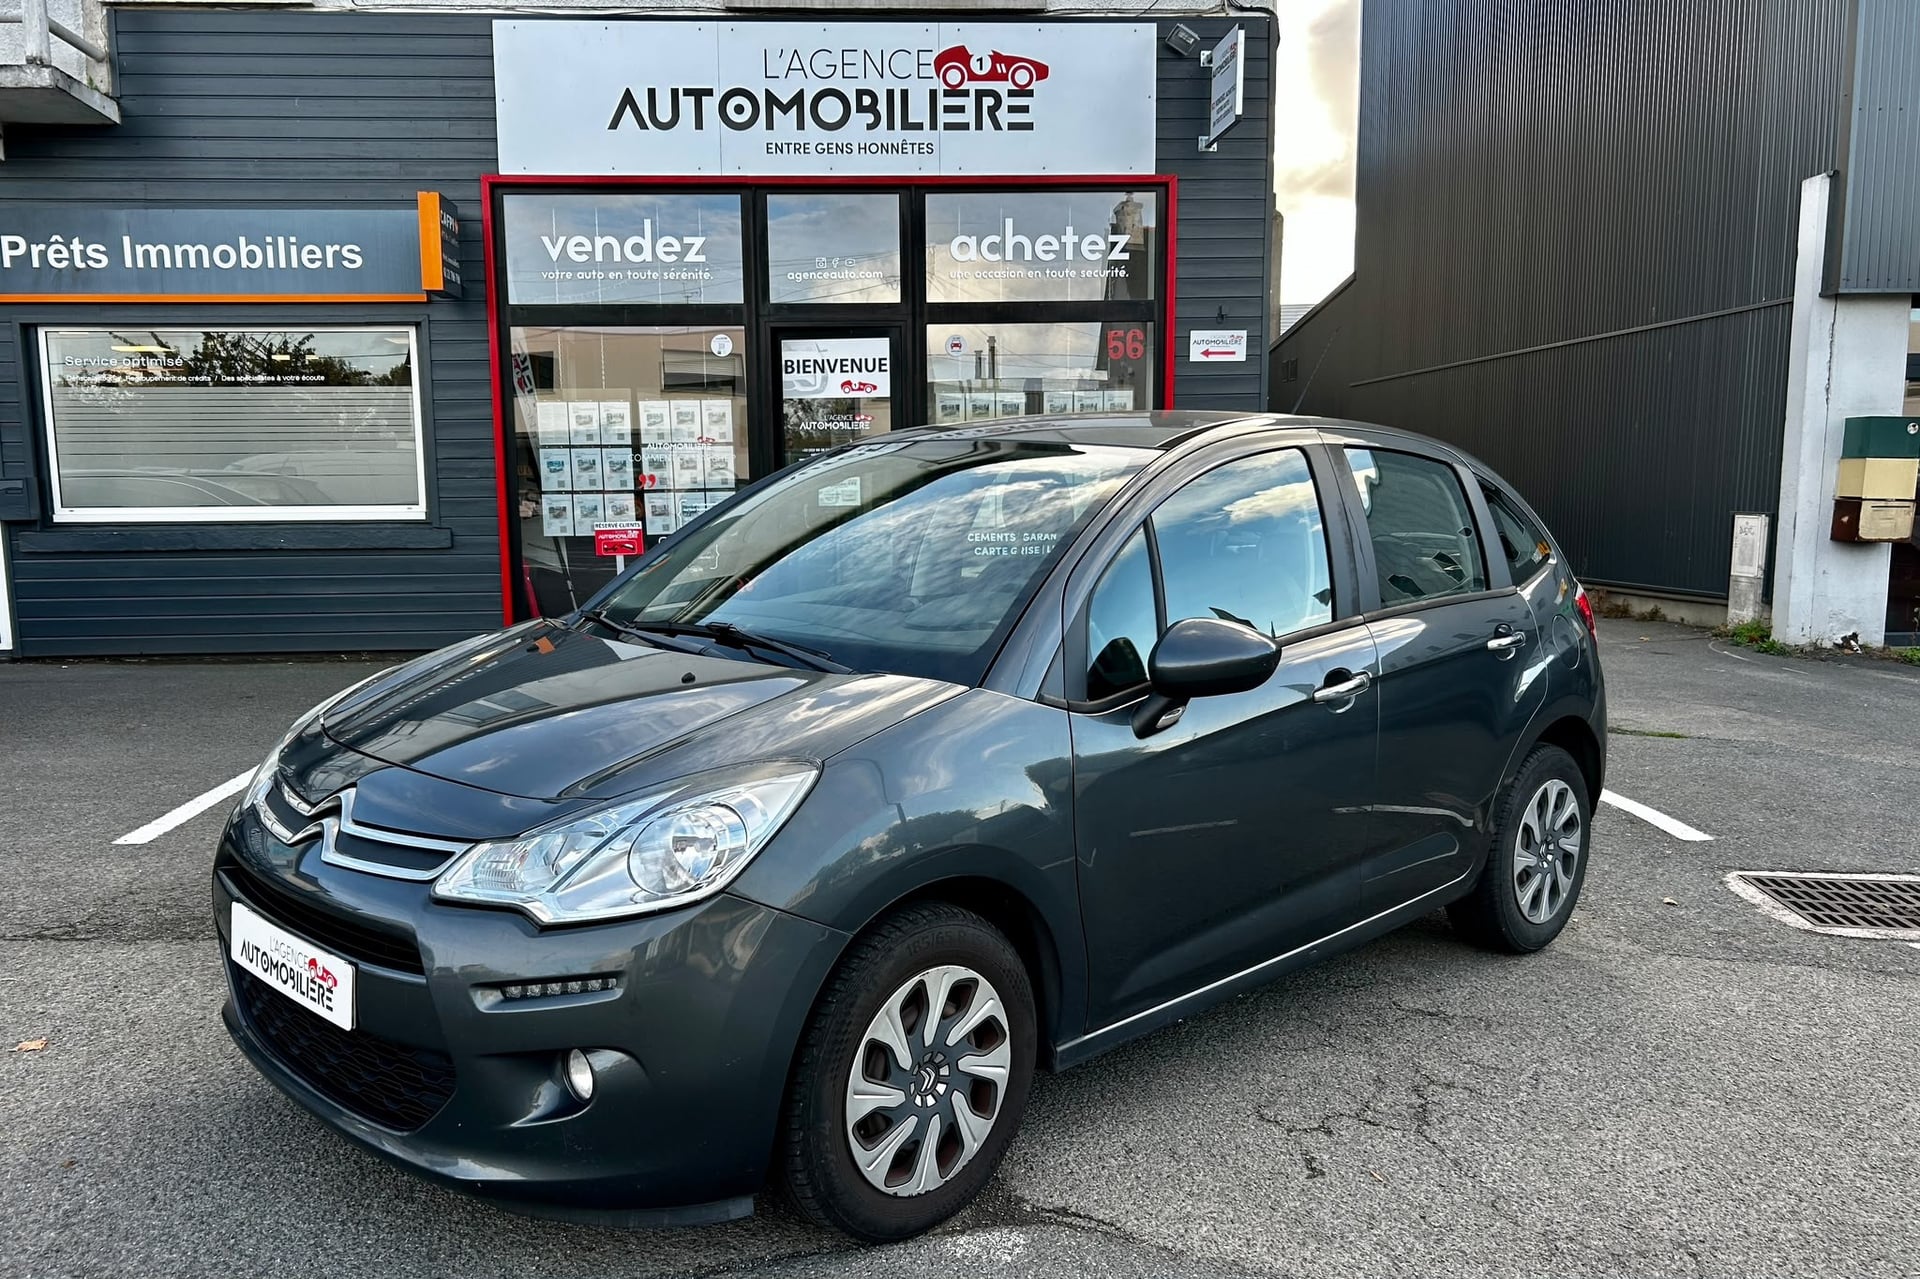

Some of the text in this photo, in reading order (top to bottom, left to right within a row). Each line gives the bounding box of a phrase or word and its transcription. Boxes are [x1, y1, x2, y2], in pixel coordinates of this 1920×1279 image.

[763, 48, 934, 80] L'AGENCE
[765, 139, 935, 155] ENTRE GENS HONNÊTES
[540, 218, 707, 263] vendez
[950, 217, 1132, 262] achetez
[0, 234, 364, 269] Prêts Immobiliers
[541, 267, 714, 280] votre auto en toute sérénité.
[787, 269, 883, 283] agenceauto.com
[950, 271, 971, 280] une
[974, 267, 1024, 279] occasion
[1027, 270, 1042, 279] en
[1045, 268, 1076, 279] toute
[1107, 328, 1145, 360] 56
[64, 355, 184, 368] Service optimisé
[783, 357, 889, 375] BIENVENUE
[974, 546, 1008, 556] CARTE
